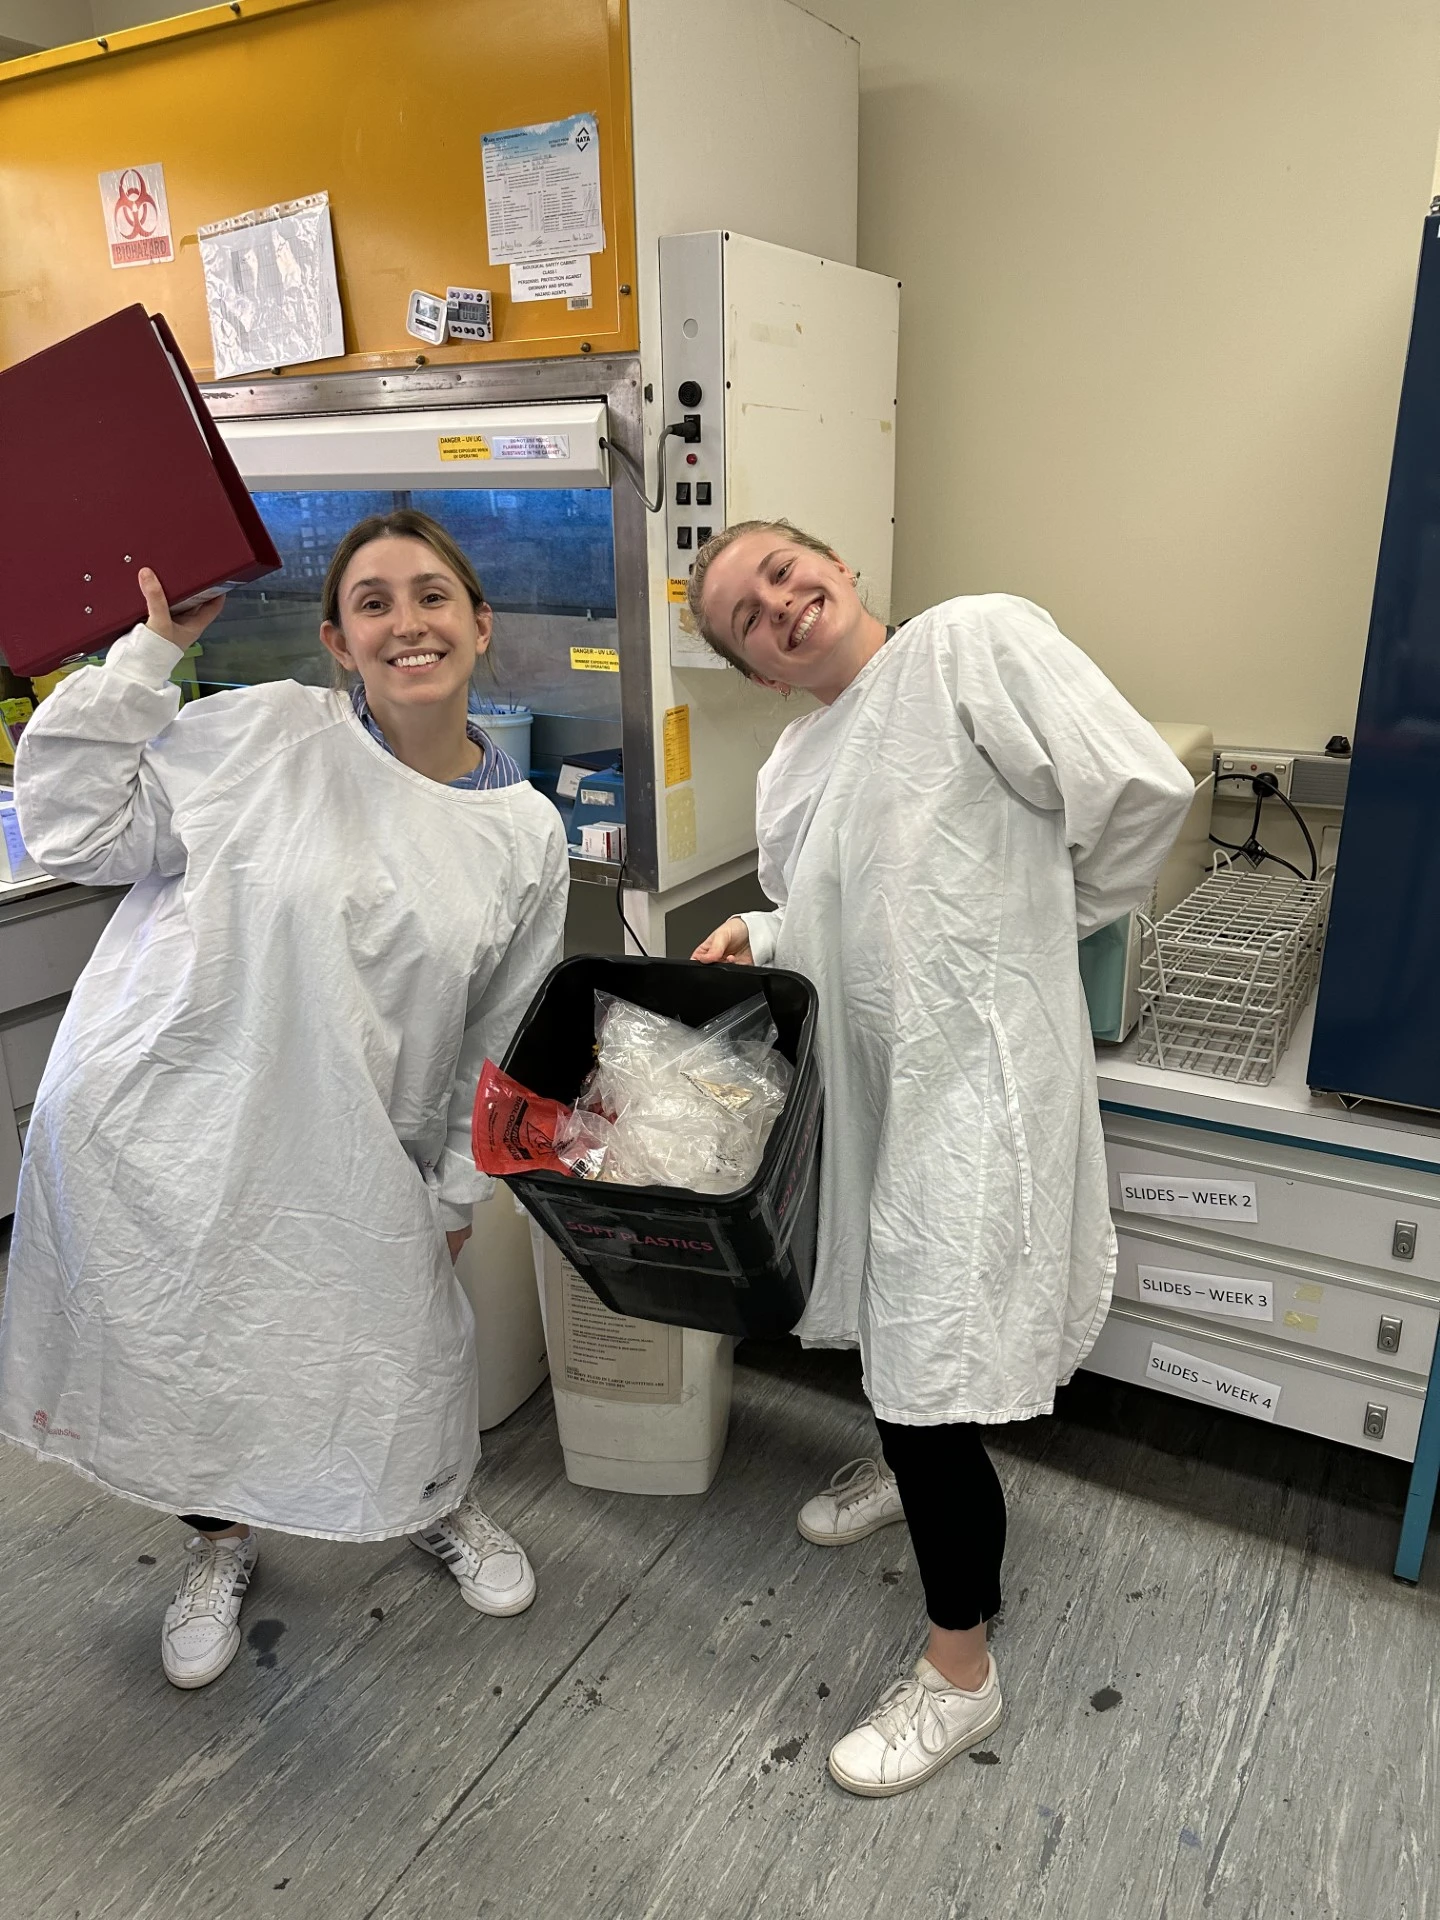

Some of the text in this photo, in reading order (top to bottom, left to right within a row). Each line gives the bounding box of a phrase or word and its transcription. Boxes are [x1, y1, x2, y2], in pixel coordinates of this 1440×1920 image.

[575, 136, 590, 144] NATA
[116, 240, 167, 261] BIOHAZARD
[440, 436, 460, 444] DANGER
[1125, 1186, 1175, 1202] SLIDES
[1192, 1191, 1238, 1206] WEEK
[1242, 1195, 1252, 1207] 2
[566, 1221, 714, 1251] SOFT PLASTICS
[1143, 1278, 1192, 1296] SLIDES
[1209, 1288, 1254, 1305] WEEK
[1258, 1295, 1267, 1307] 3
[1151, 1358, 1199, 1383] SLIDES
[1216, 1380, 1259, 1405] WEEK
[1262, 1398, 1272, 1409] 4
